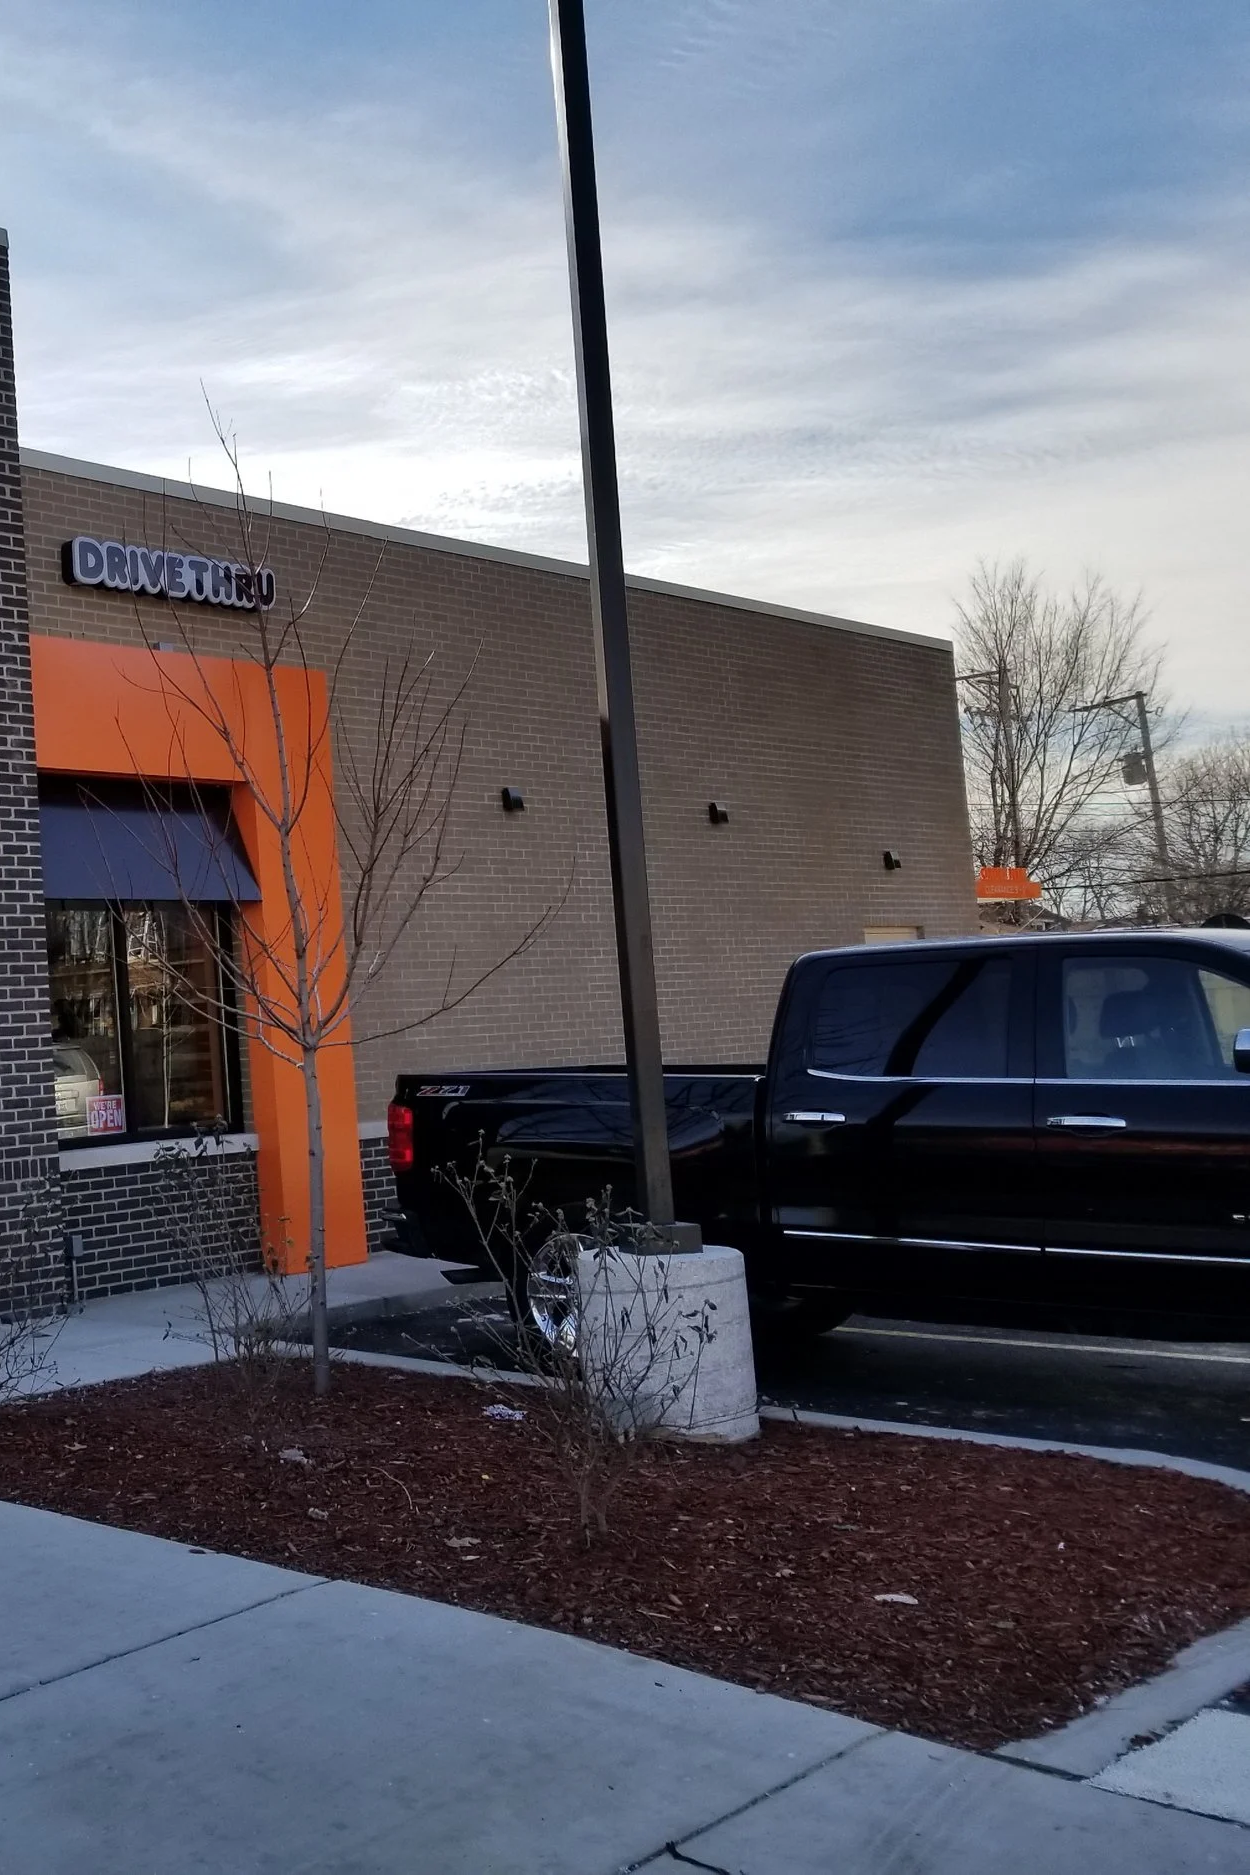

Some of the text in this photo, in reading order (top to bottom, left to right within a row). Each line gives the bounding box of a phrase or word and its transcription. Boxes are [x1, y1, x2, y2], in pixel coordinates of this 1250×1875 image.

[416, 1085, 471, 1097] Z71
[93, 1100, 117, 1110] WE'RE
[90, 1109, 122, 1129] OPEN
